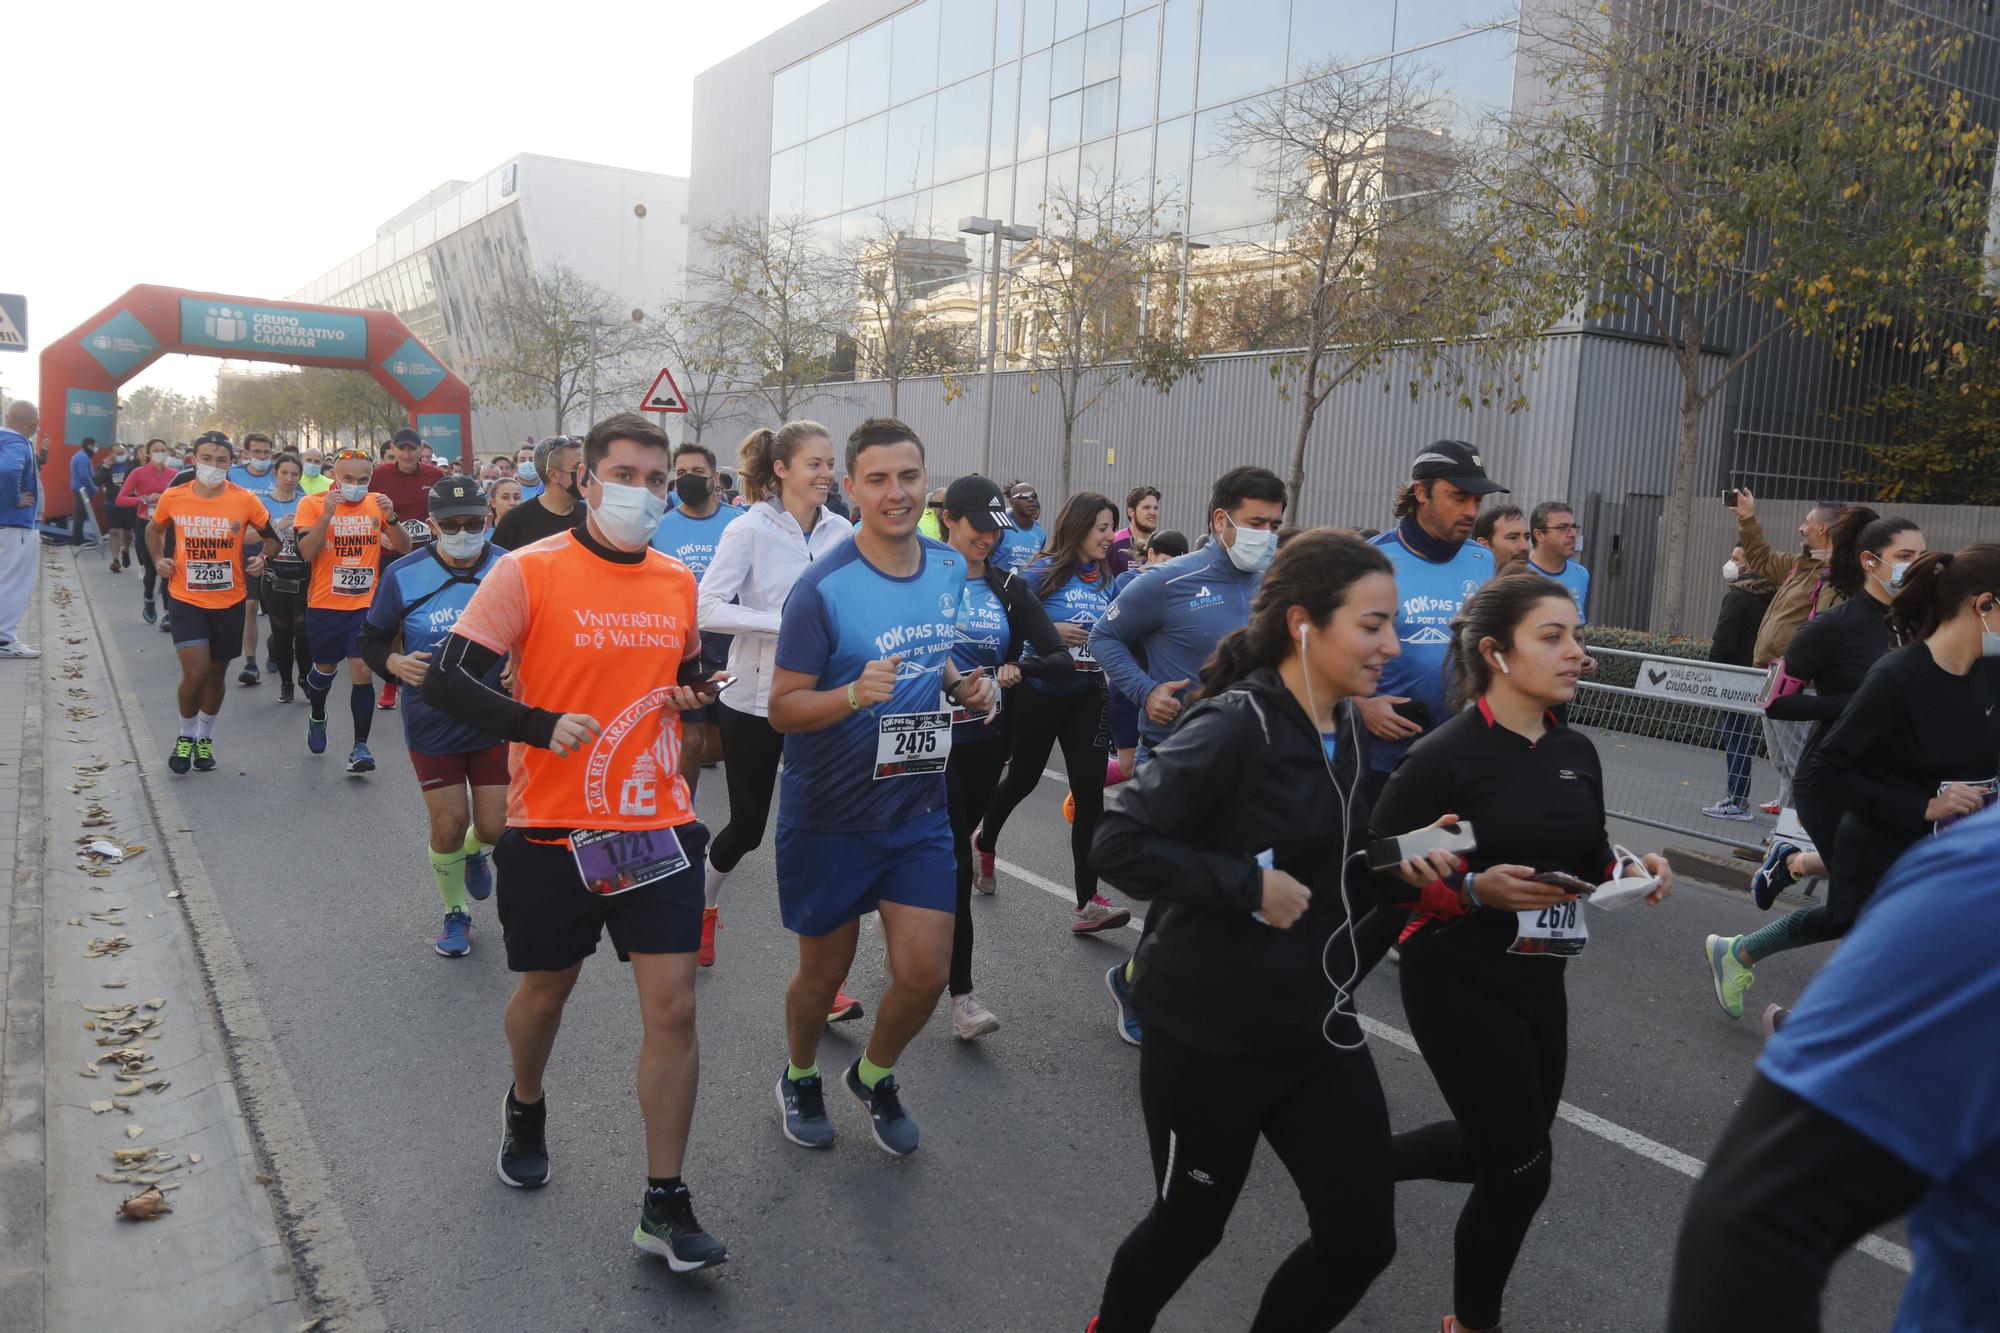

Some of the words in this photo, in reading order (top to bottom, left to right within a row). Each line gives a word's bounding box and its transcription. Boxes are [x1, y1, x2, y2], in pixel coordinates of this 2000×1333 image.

[252, 313, 299, 326] GRUPO
[253, 323, 345, 340] COOPERATIVO
[253, 333, 316, 348] CAJAMAR
[330, 515, 372, 525] ALENCIA
[183, 526, 230, 539] BASKET
[334, 525, 372, 536] BASKET
[185, 537, 234, 549] RUNNING
[334, 535, 378, 547] RUNNING
[186, 549, 217, 560] TEAM
[335, 546, 363, 558] TEAM
[676, 543, 694, 557] 10K
[694, 544, 713, 553] PAS
[194, 569, 224, 581] 2293
[341, 574, 367, 586] 2292
[1065, 588, 1084, 603] 10K
[1190, 600, 1200, 608] EL
[1200, 594, 1223, 604] PILAR
[1403, 595, 1430, 616] 10K
[1429, 599, 1453, 612] PAS
[429, 607, 455, 626] 10K
[573, 609, 678, 629] VNIVERSITAT
[978, 608, 1001, 623] RAS
[1405, 616, 1414, 625] AL
[1417, 616, 1436, 625] PORT
[1437, 617, 1448, 625] DE
[430, 625, 439, 633] AL
[608, 629, 681, 649] VALÈNCIA
[875, 625, 906, 655] 10K
[905, 623, 932, 642] PAS
[935, 623, 956, 639] RAS
[914, 646, 925, 656] DE
[1078, 644, 1093, 658] 29
[1670, 669, 1712, 683] VALENCIA
[1665, 680, 1699, 695] CIUDAD
[1701, 685, 1718, 698] DEL
[894, 730, 937, 756] 2475
[591, 750, 609, 777] REX
[602, 829, 655, 866] 1721
[1536, 901, 1577, 929] 2678
